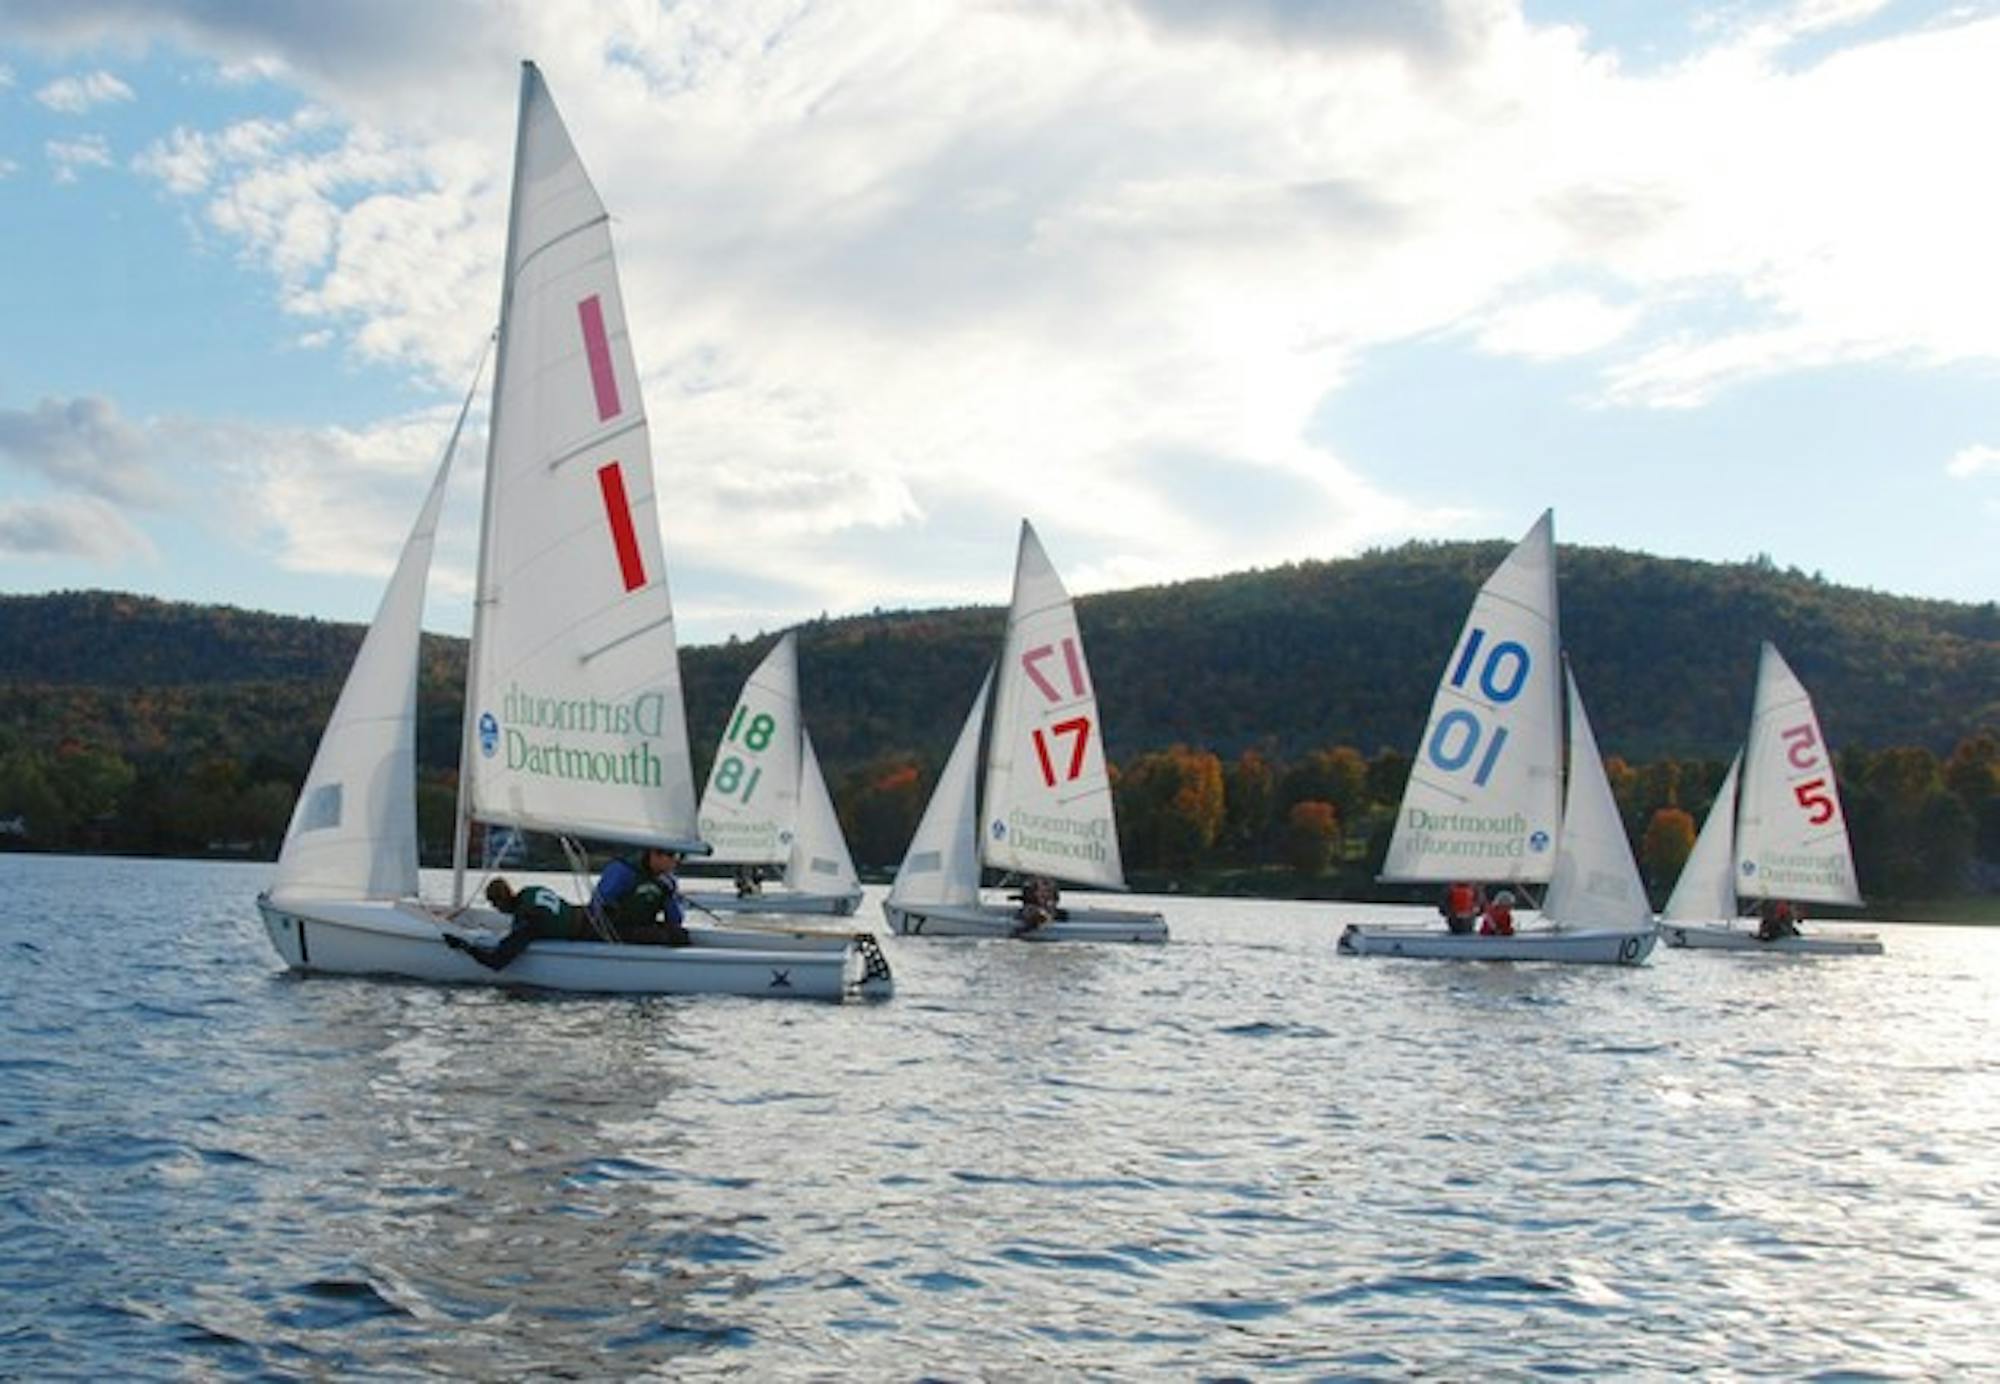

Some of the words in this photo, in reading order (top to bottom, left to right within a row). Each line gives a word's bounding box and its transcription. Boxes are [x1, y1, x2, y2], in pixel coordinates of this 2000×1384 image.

[597, 460, 647, 593] 1
[1451, 628, 1531, 704] 10
[729, 704, 775, 751] 18
[505, 728, 662, 787] Dartmouth
[1032, 716, 1090, 788] 17
[1409, 808, 1528, 837] Dartmouth
[1794, 778, 1835, 825] 5
[903, 913, 927, 935] 17
[1618, 937, 1641, 962] 10
